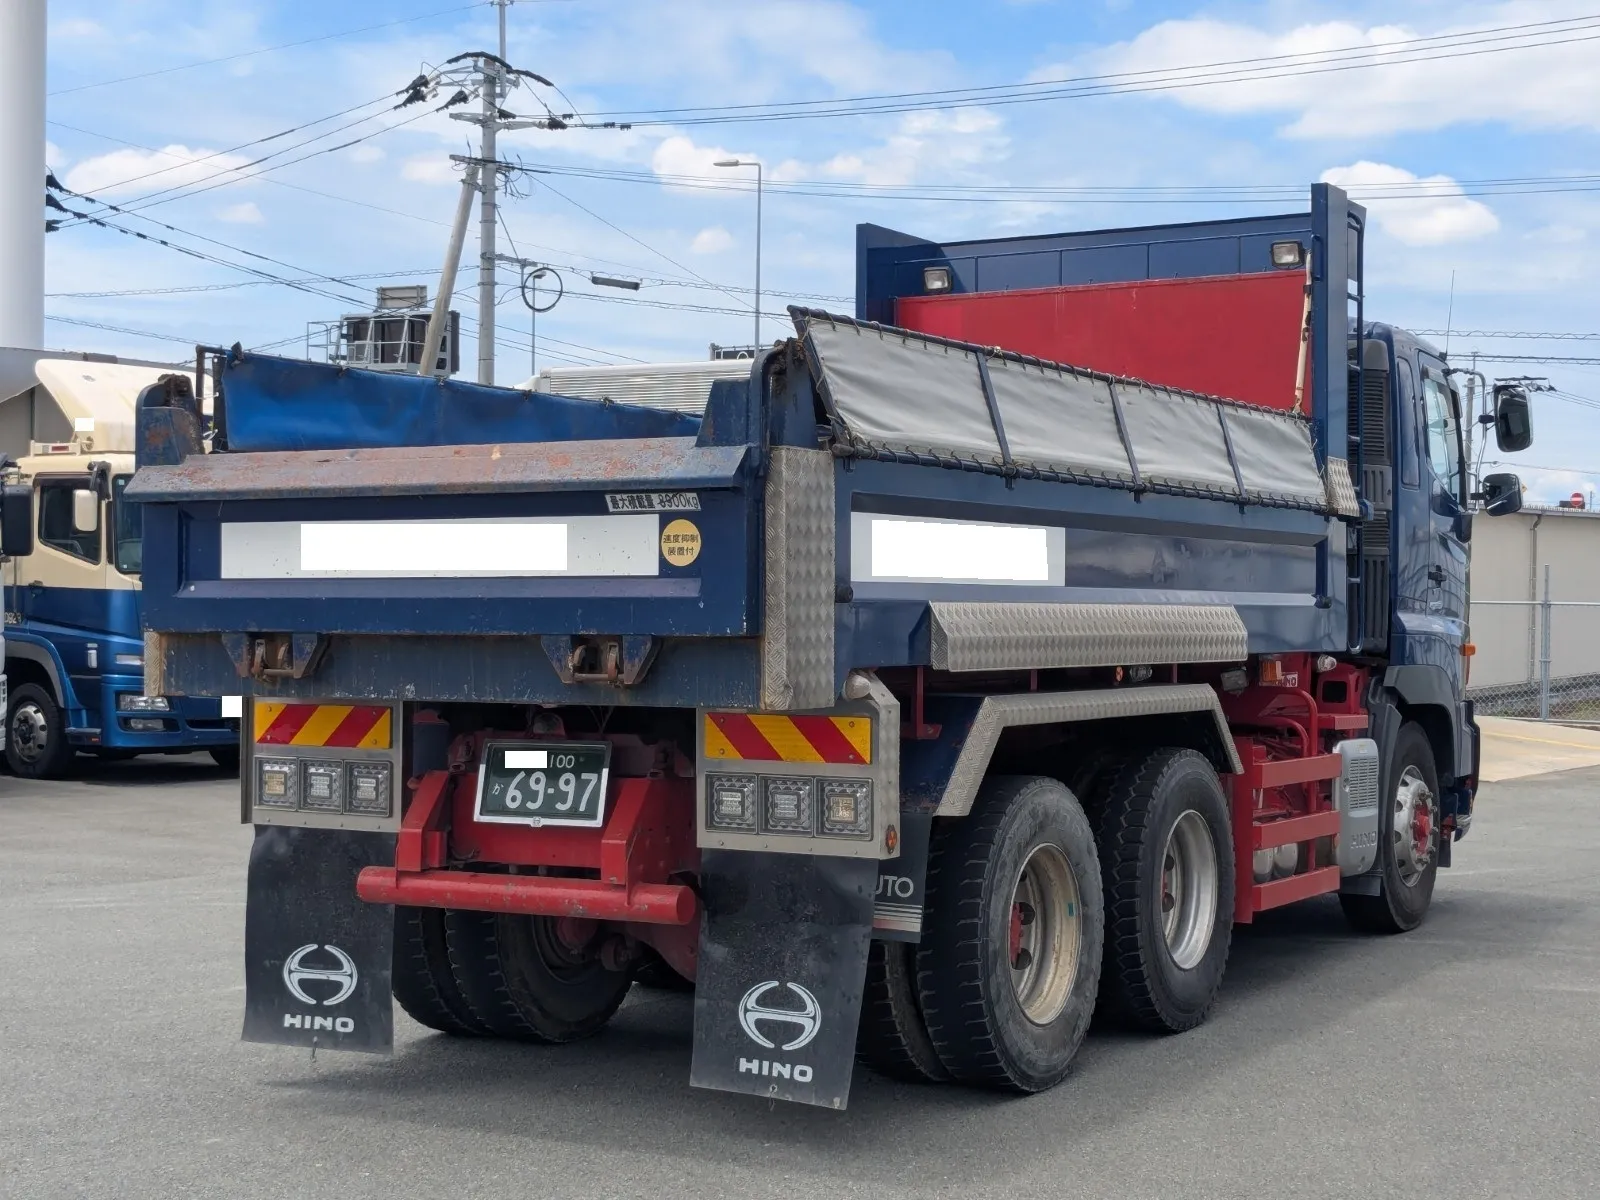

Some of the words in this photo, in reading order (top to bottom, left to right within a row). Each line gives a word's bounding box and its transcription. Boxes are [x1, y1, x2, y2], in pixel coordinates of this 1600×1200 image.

[663, 534, 699, 543] 速度抑制
[667, 546, 694, 556] 装置付
[549, 754, 575, 768] 100
[492, 782, 504, 795] か
[505, 770, 598, 812] 69-97
[283, 1013, 354, 1033] HINO
[739, 1057, 813, 1083] HINO
